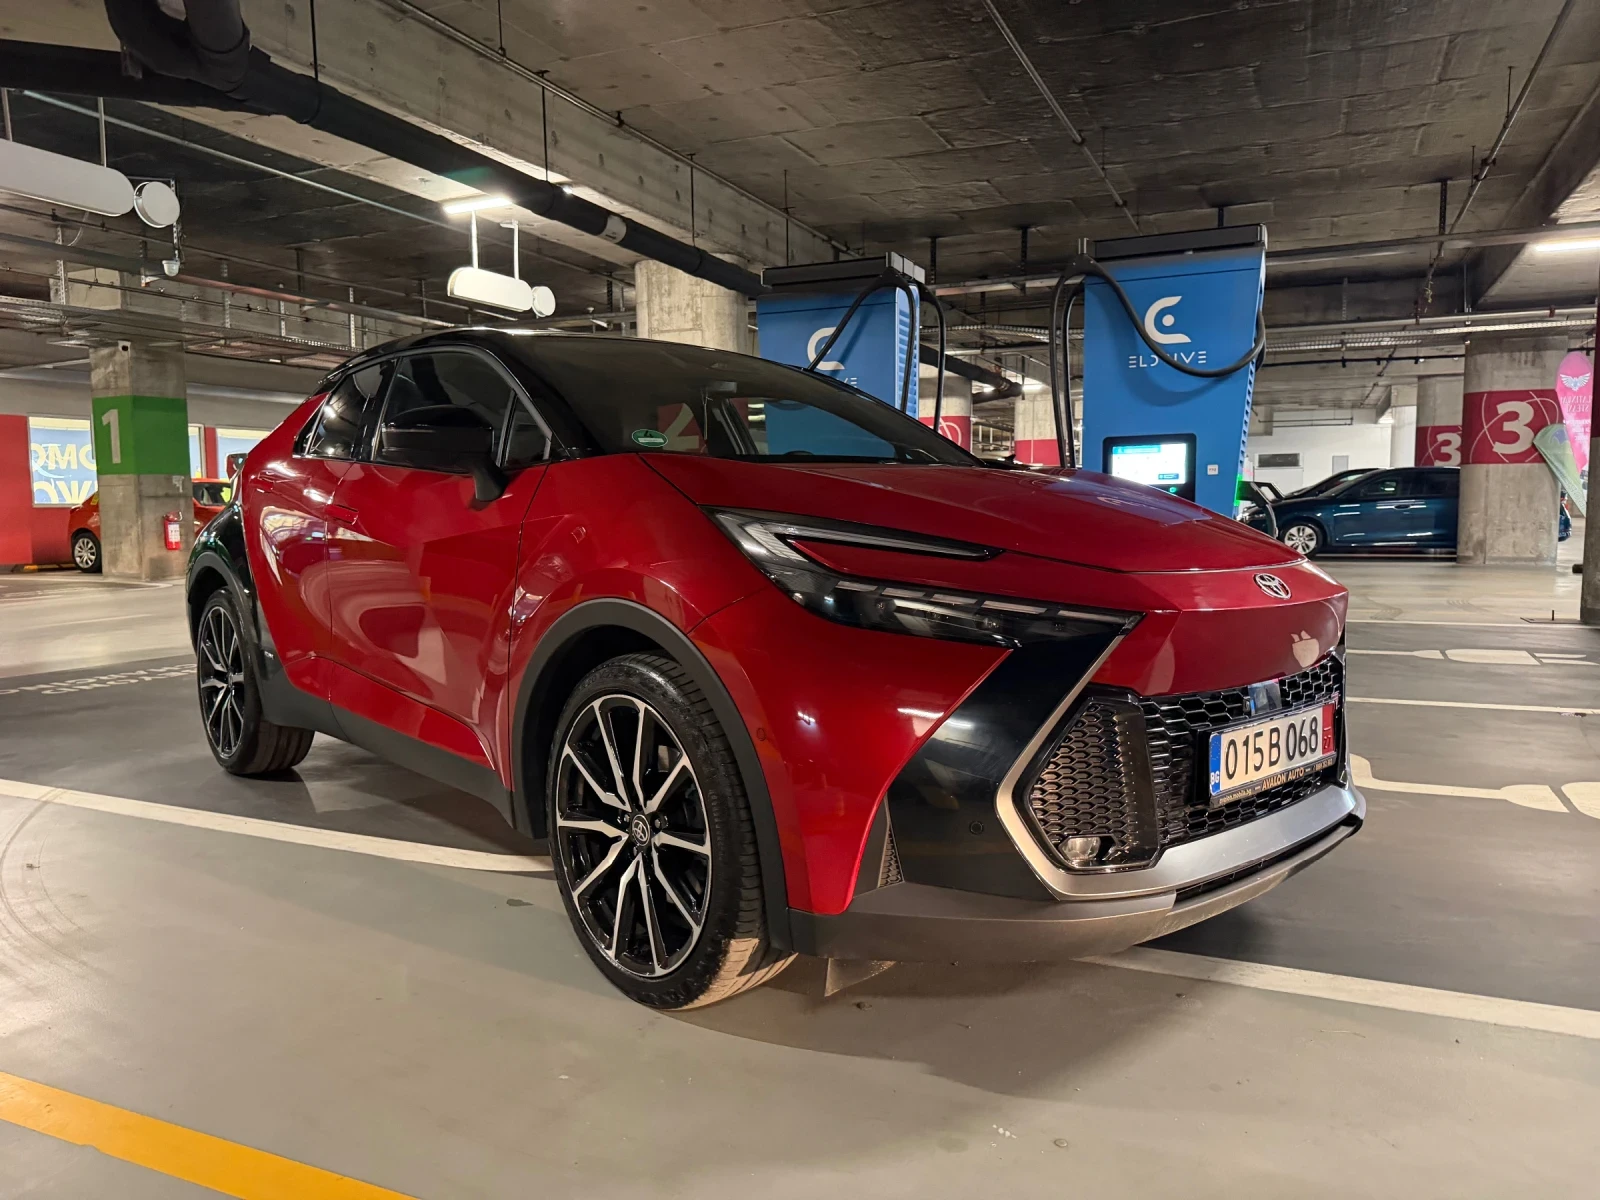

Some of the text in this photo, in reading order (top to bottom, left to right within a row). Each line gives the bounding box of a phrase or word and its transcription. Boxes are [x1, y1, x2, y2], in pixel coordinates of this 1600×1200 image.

[1128, 351, 1207, 368] ELDIVE
[101, 408, 121, 464] 1
[1493, 401, 1535, 454] 3
[1433, 432, 1462, 466] 3
[1210, 771, 1220, 785] BG
[1262, 772, 1286, 791] AVALON
[1287, 767, 1305, 782] AUTO
